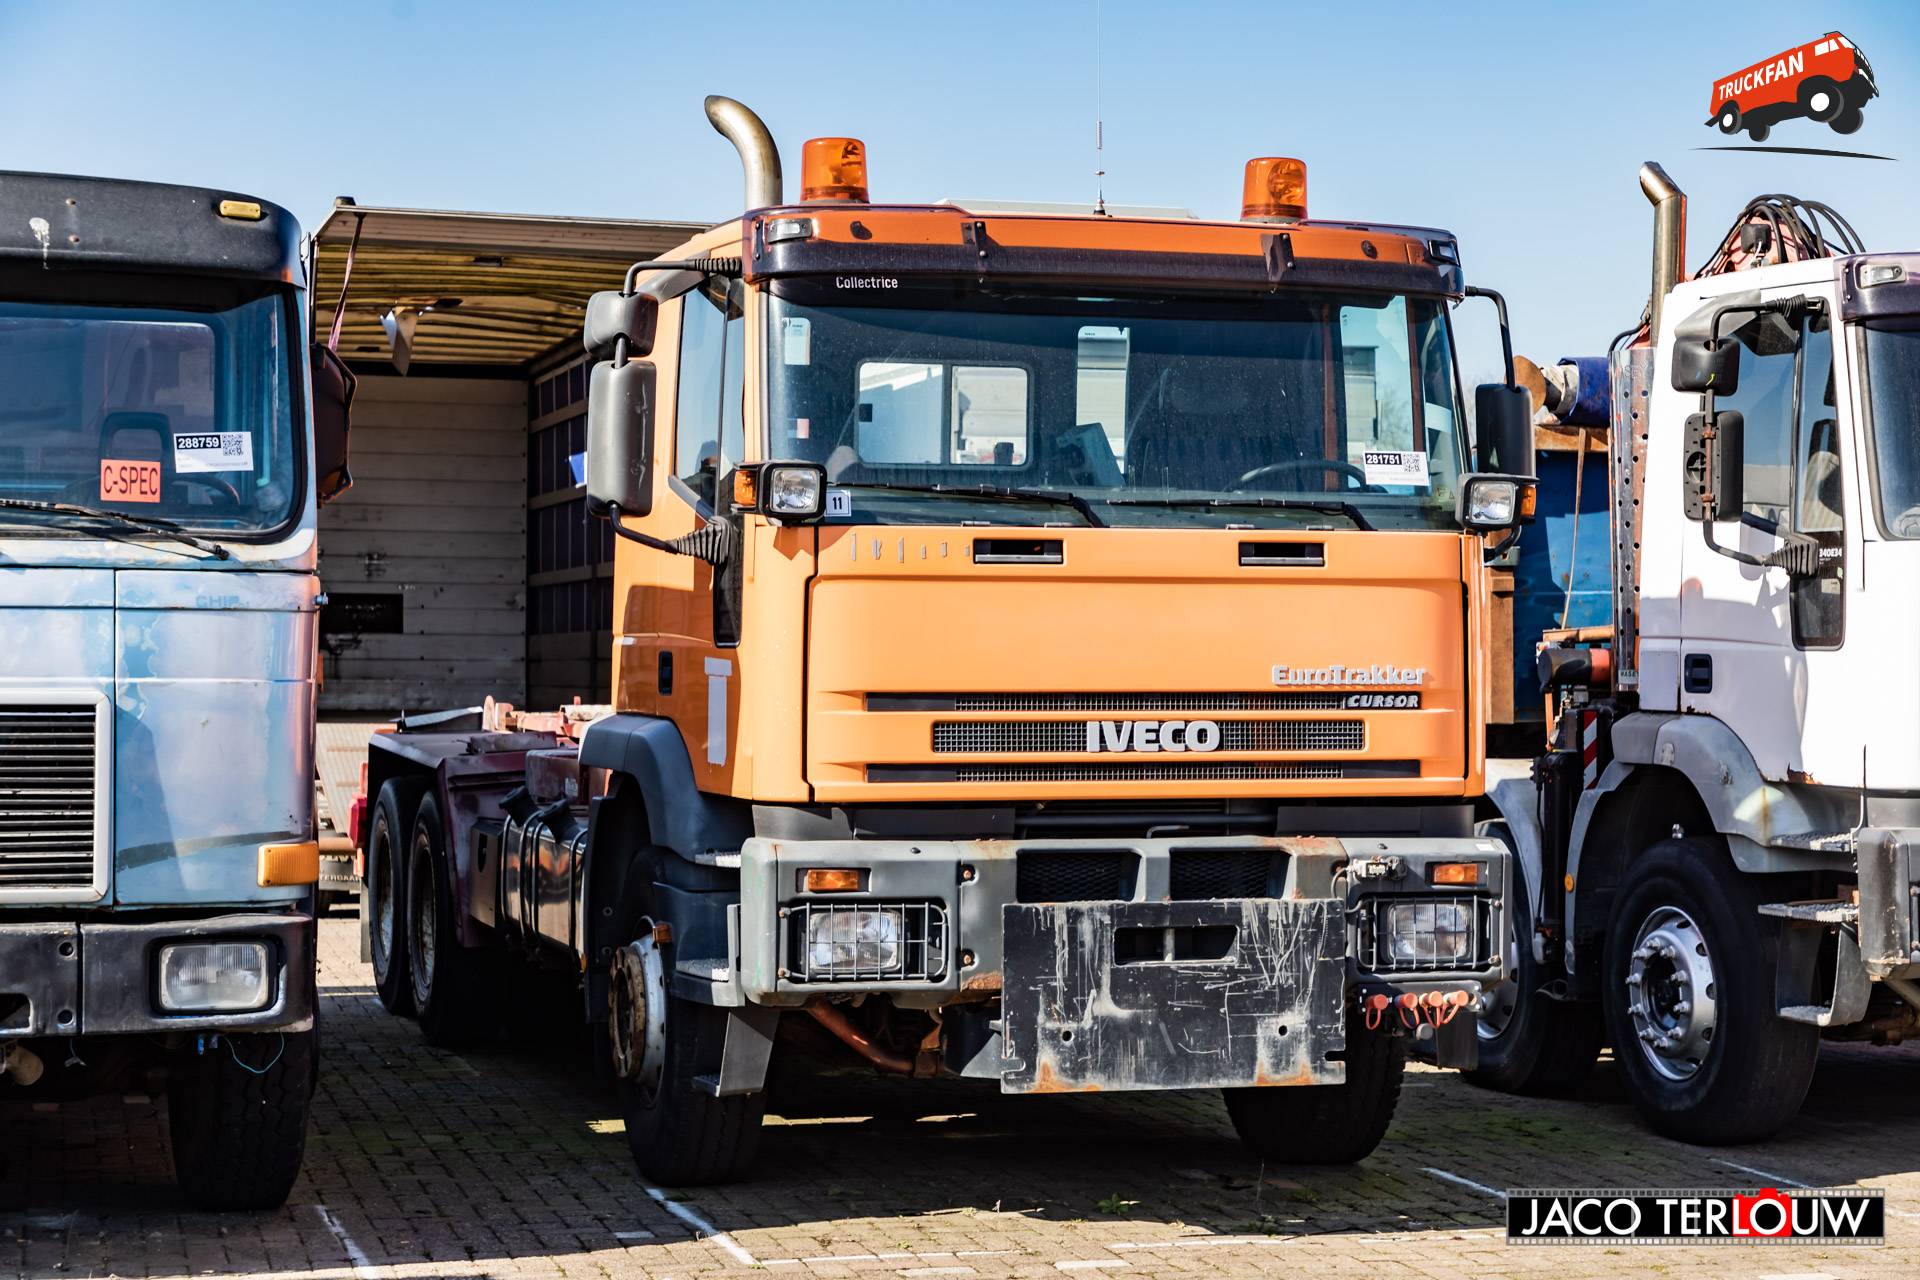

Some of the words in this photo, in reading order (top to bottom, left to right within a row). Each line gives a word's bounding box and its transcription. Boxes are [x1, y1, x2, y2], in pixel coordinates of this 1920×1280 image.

[835, 276, 899, 289] Collectrice
[177, 436, 220, 449] 288759
[1366, 454, 1401, 465] 281751
[103, 465, 159, 496] C-SPEC
[832, 496, 843, 510] 11
[1271, 664, 1426, 686] EuroTrakker
[1347, 694, 1419, 708] CURSOR
[1086, 720, 1221, 753] IVECO
